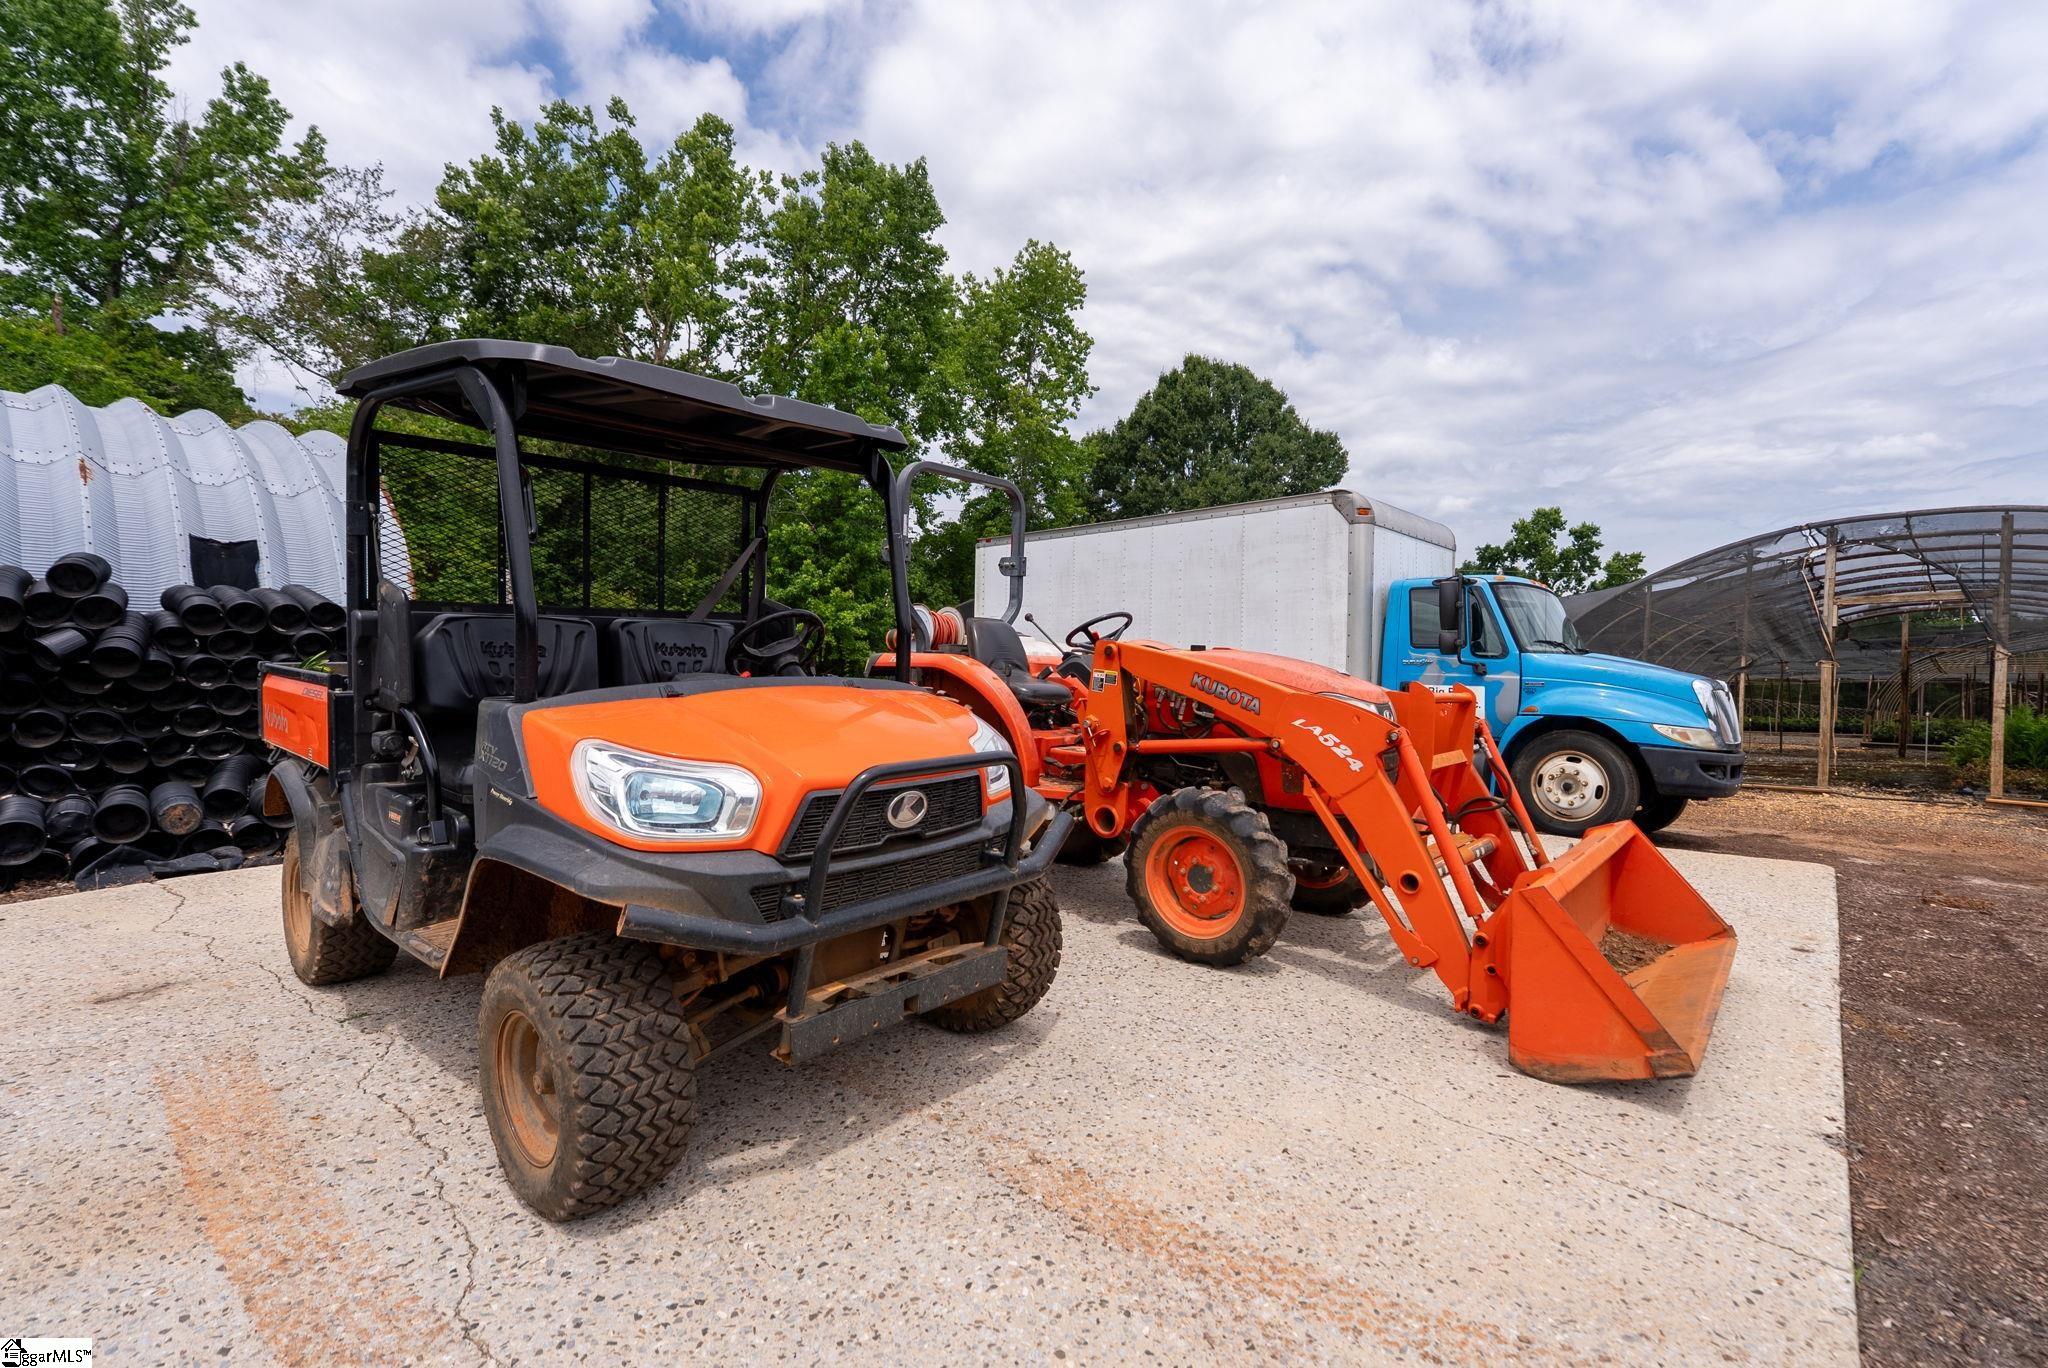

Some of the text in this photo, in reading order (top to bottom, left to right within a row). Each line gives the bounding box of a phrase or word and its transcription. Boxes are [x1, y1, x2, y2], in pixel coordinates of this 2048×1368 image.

[480, 640, 547, 658] Kuba
[655, 641, 707, 658] Kubota
[1190, 672, 1262, 716] KUBOTA
[265, 704, 289, 734] Kubota
[1291, 718, 1364, 772] LA524
